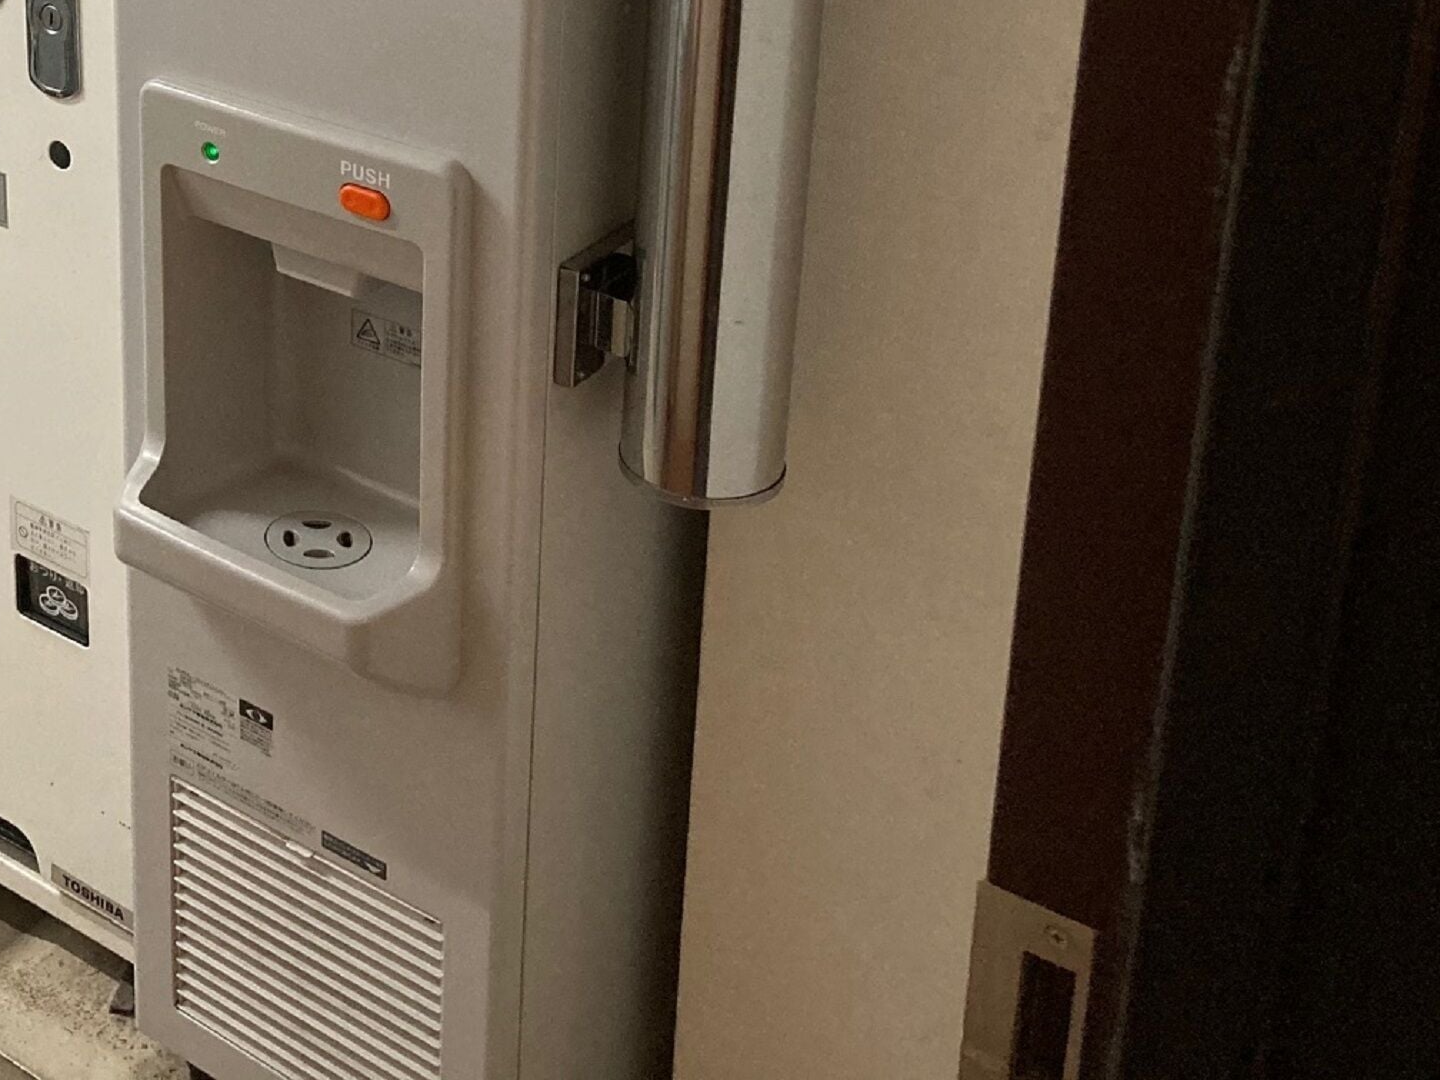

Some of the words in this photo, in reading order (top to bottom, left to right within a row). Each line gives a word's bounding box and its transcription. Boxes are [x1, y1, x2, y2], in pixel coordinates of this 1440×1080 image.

[193, 120, 227, 137] POWER
[339, 159, 391, 189] PUSH
[62, 874, 124, 921] TOSHIBA
